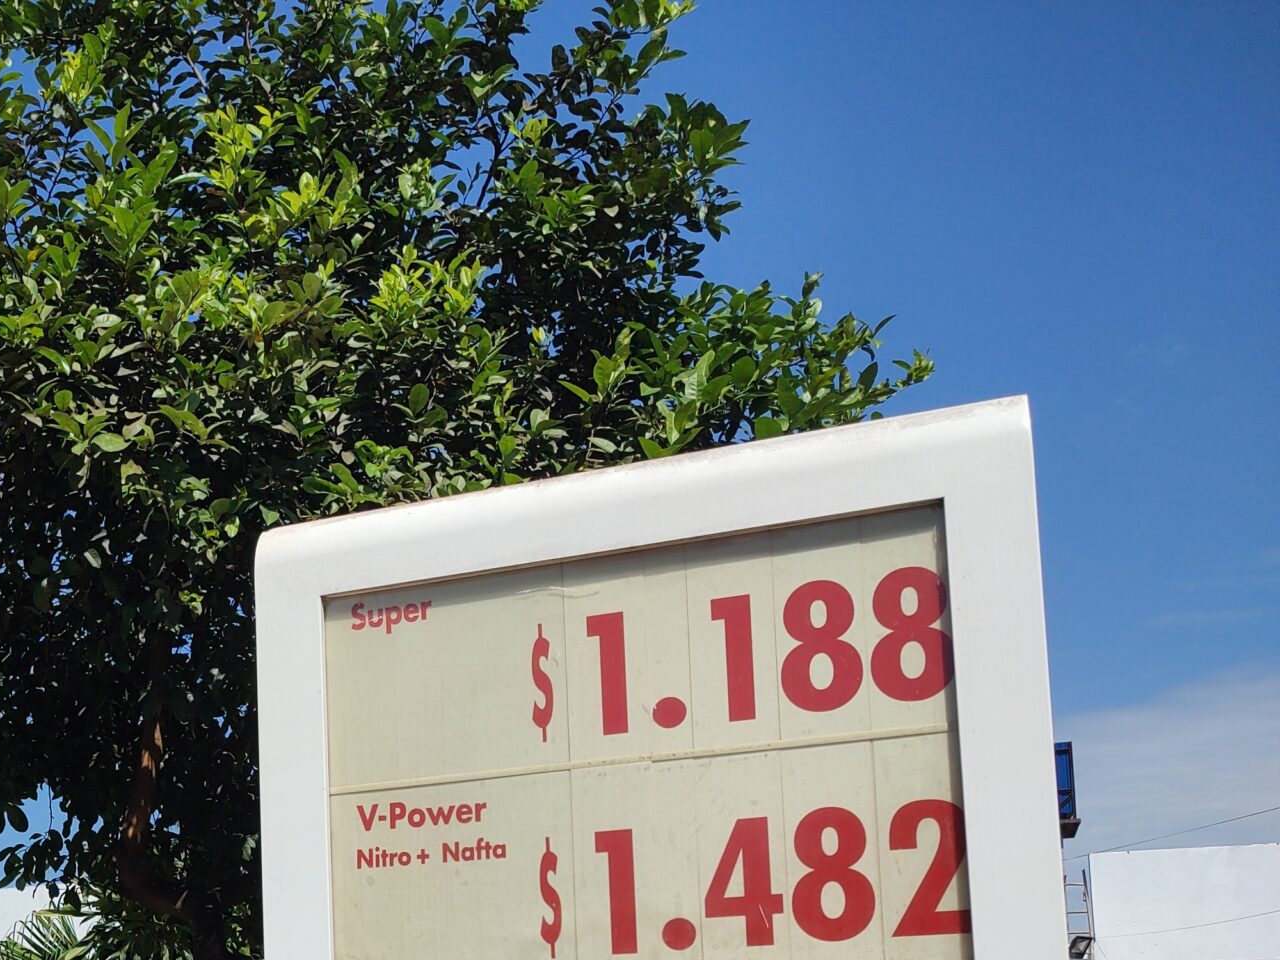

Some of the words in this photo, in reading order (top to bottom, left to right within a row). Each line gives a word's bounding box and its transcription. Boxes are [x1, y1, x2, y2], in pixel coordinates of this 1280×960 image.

[351, 597, 433, 635] Super
[532, 624, 555, 742] $
[586, 566, 957, 737] 1.188
[357, 801, 487, 832] V-Power
[442, 838, 508, 864] Nafta
[540, 837, 563, 960] $
[595, 798, 973, 956] 1.482
